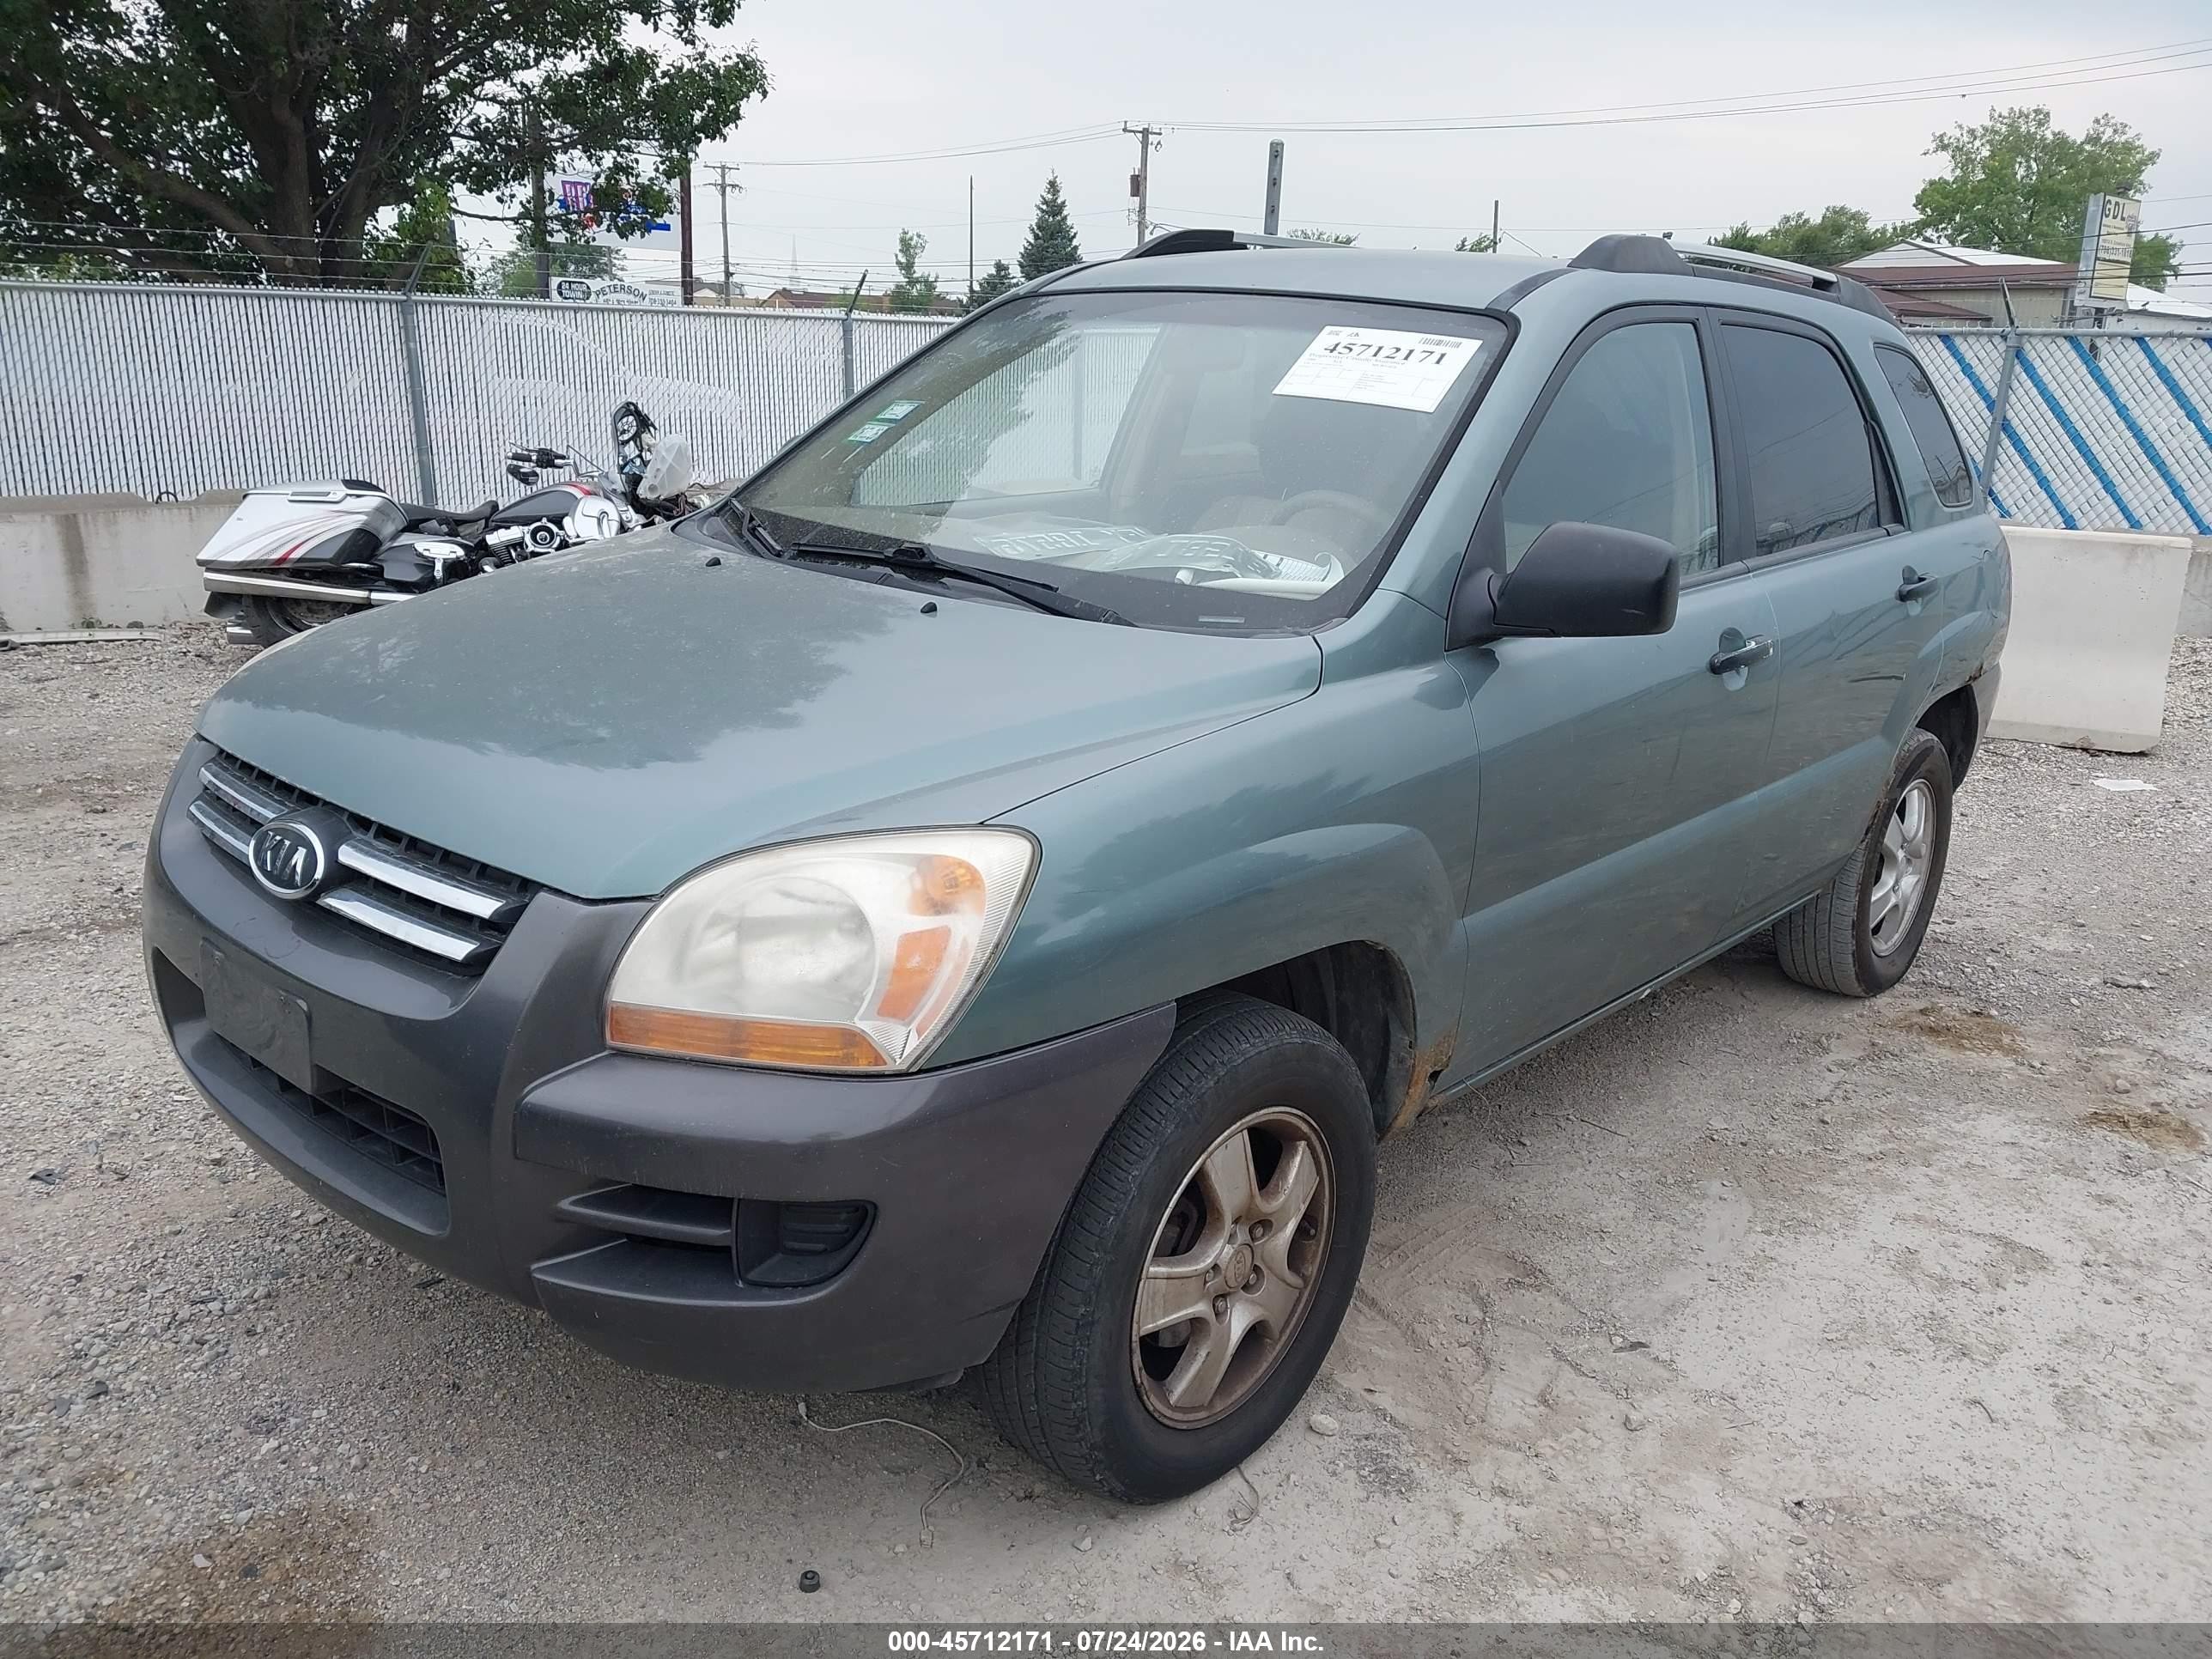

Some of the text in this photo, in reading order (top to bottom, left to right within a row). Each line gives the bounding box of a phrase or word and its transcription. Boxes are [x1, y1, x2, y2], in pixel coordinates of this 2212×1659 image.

[2104, 198, 2126, 222] GDL
[570, 283, 587, 292] HOUR
[593, 283, 647, 301] PETERSON
[1323, 341, 1448, 365] 45712171
[258, 830, 307, 886] KIA
